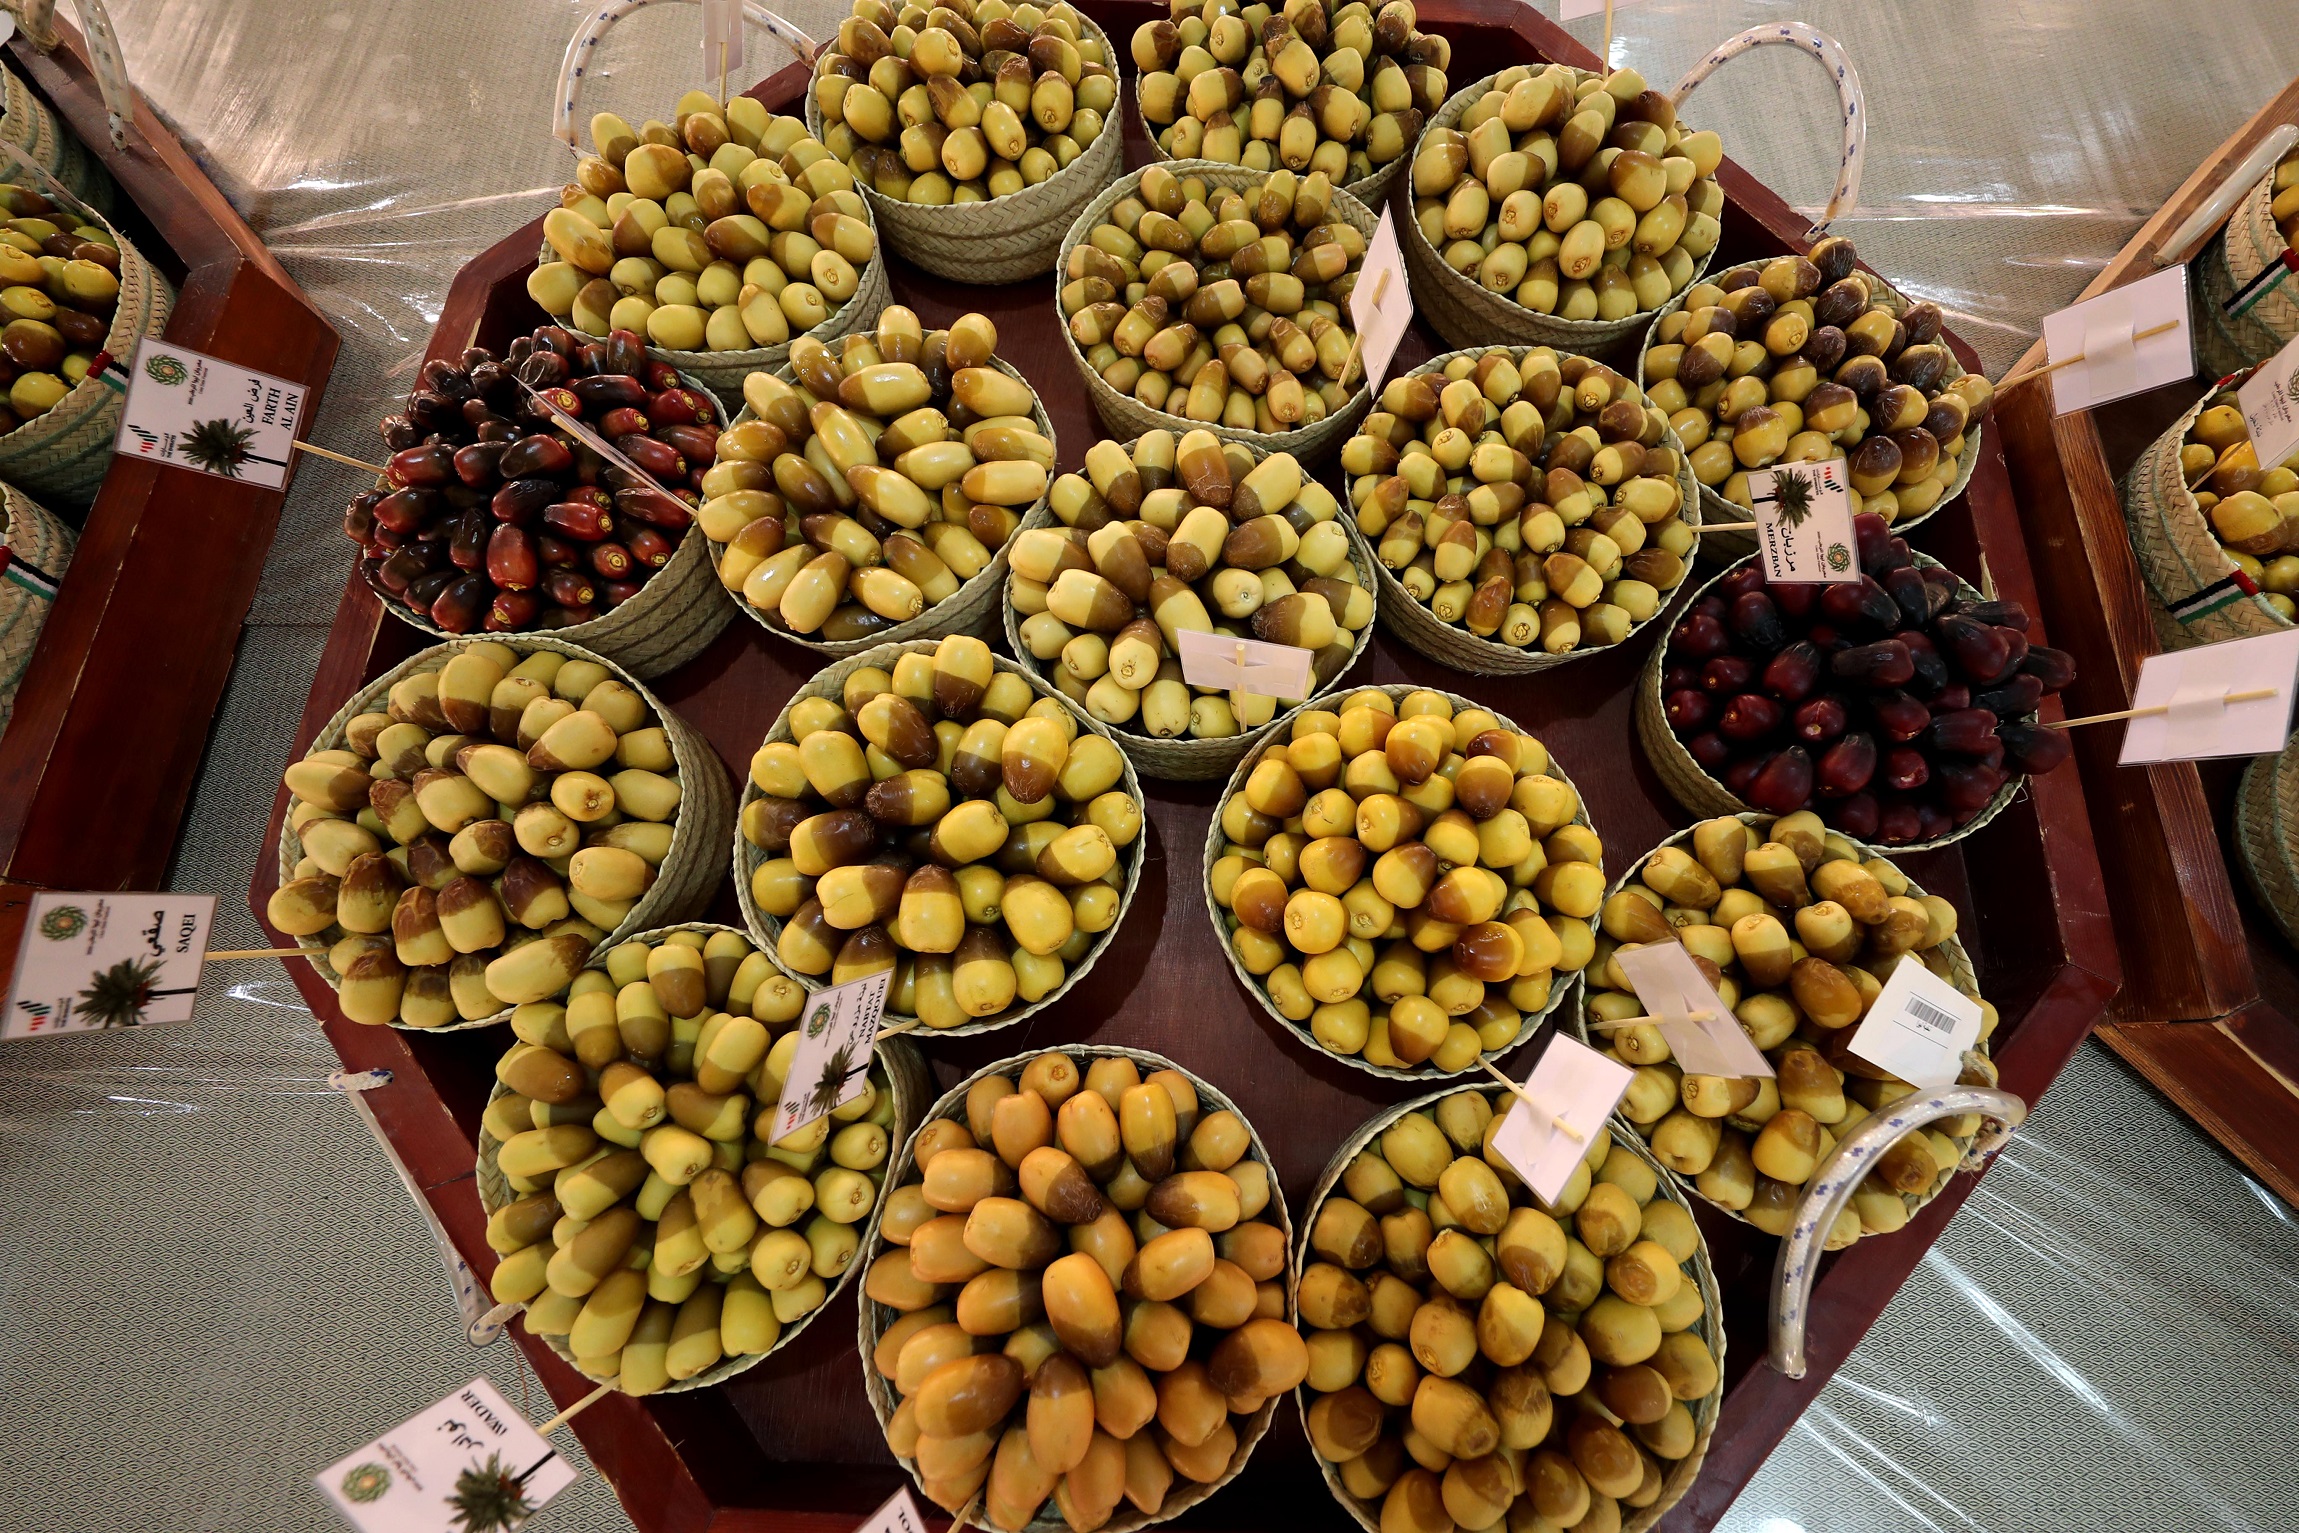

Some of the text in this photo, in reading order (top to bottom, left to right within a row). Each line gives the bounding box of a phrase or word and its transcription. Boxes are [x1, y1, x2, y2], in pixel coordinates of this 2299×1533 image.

[243, 379, 262, 423] فرض العين
[262, 387, 281, 425] FARTH
[281, 393, 298, 431] AL AIN
[1765, 522, 1782, 578] MERZBAN
[1780, 527, 1797, 572] مرزبان
[142, 910, 166, 957] صقعي
[176, 914, 197, 953] SAQEI
[859, 991, 875, 1038] NABTAT
[437, 1418, 484, 1449] نوادر
